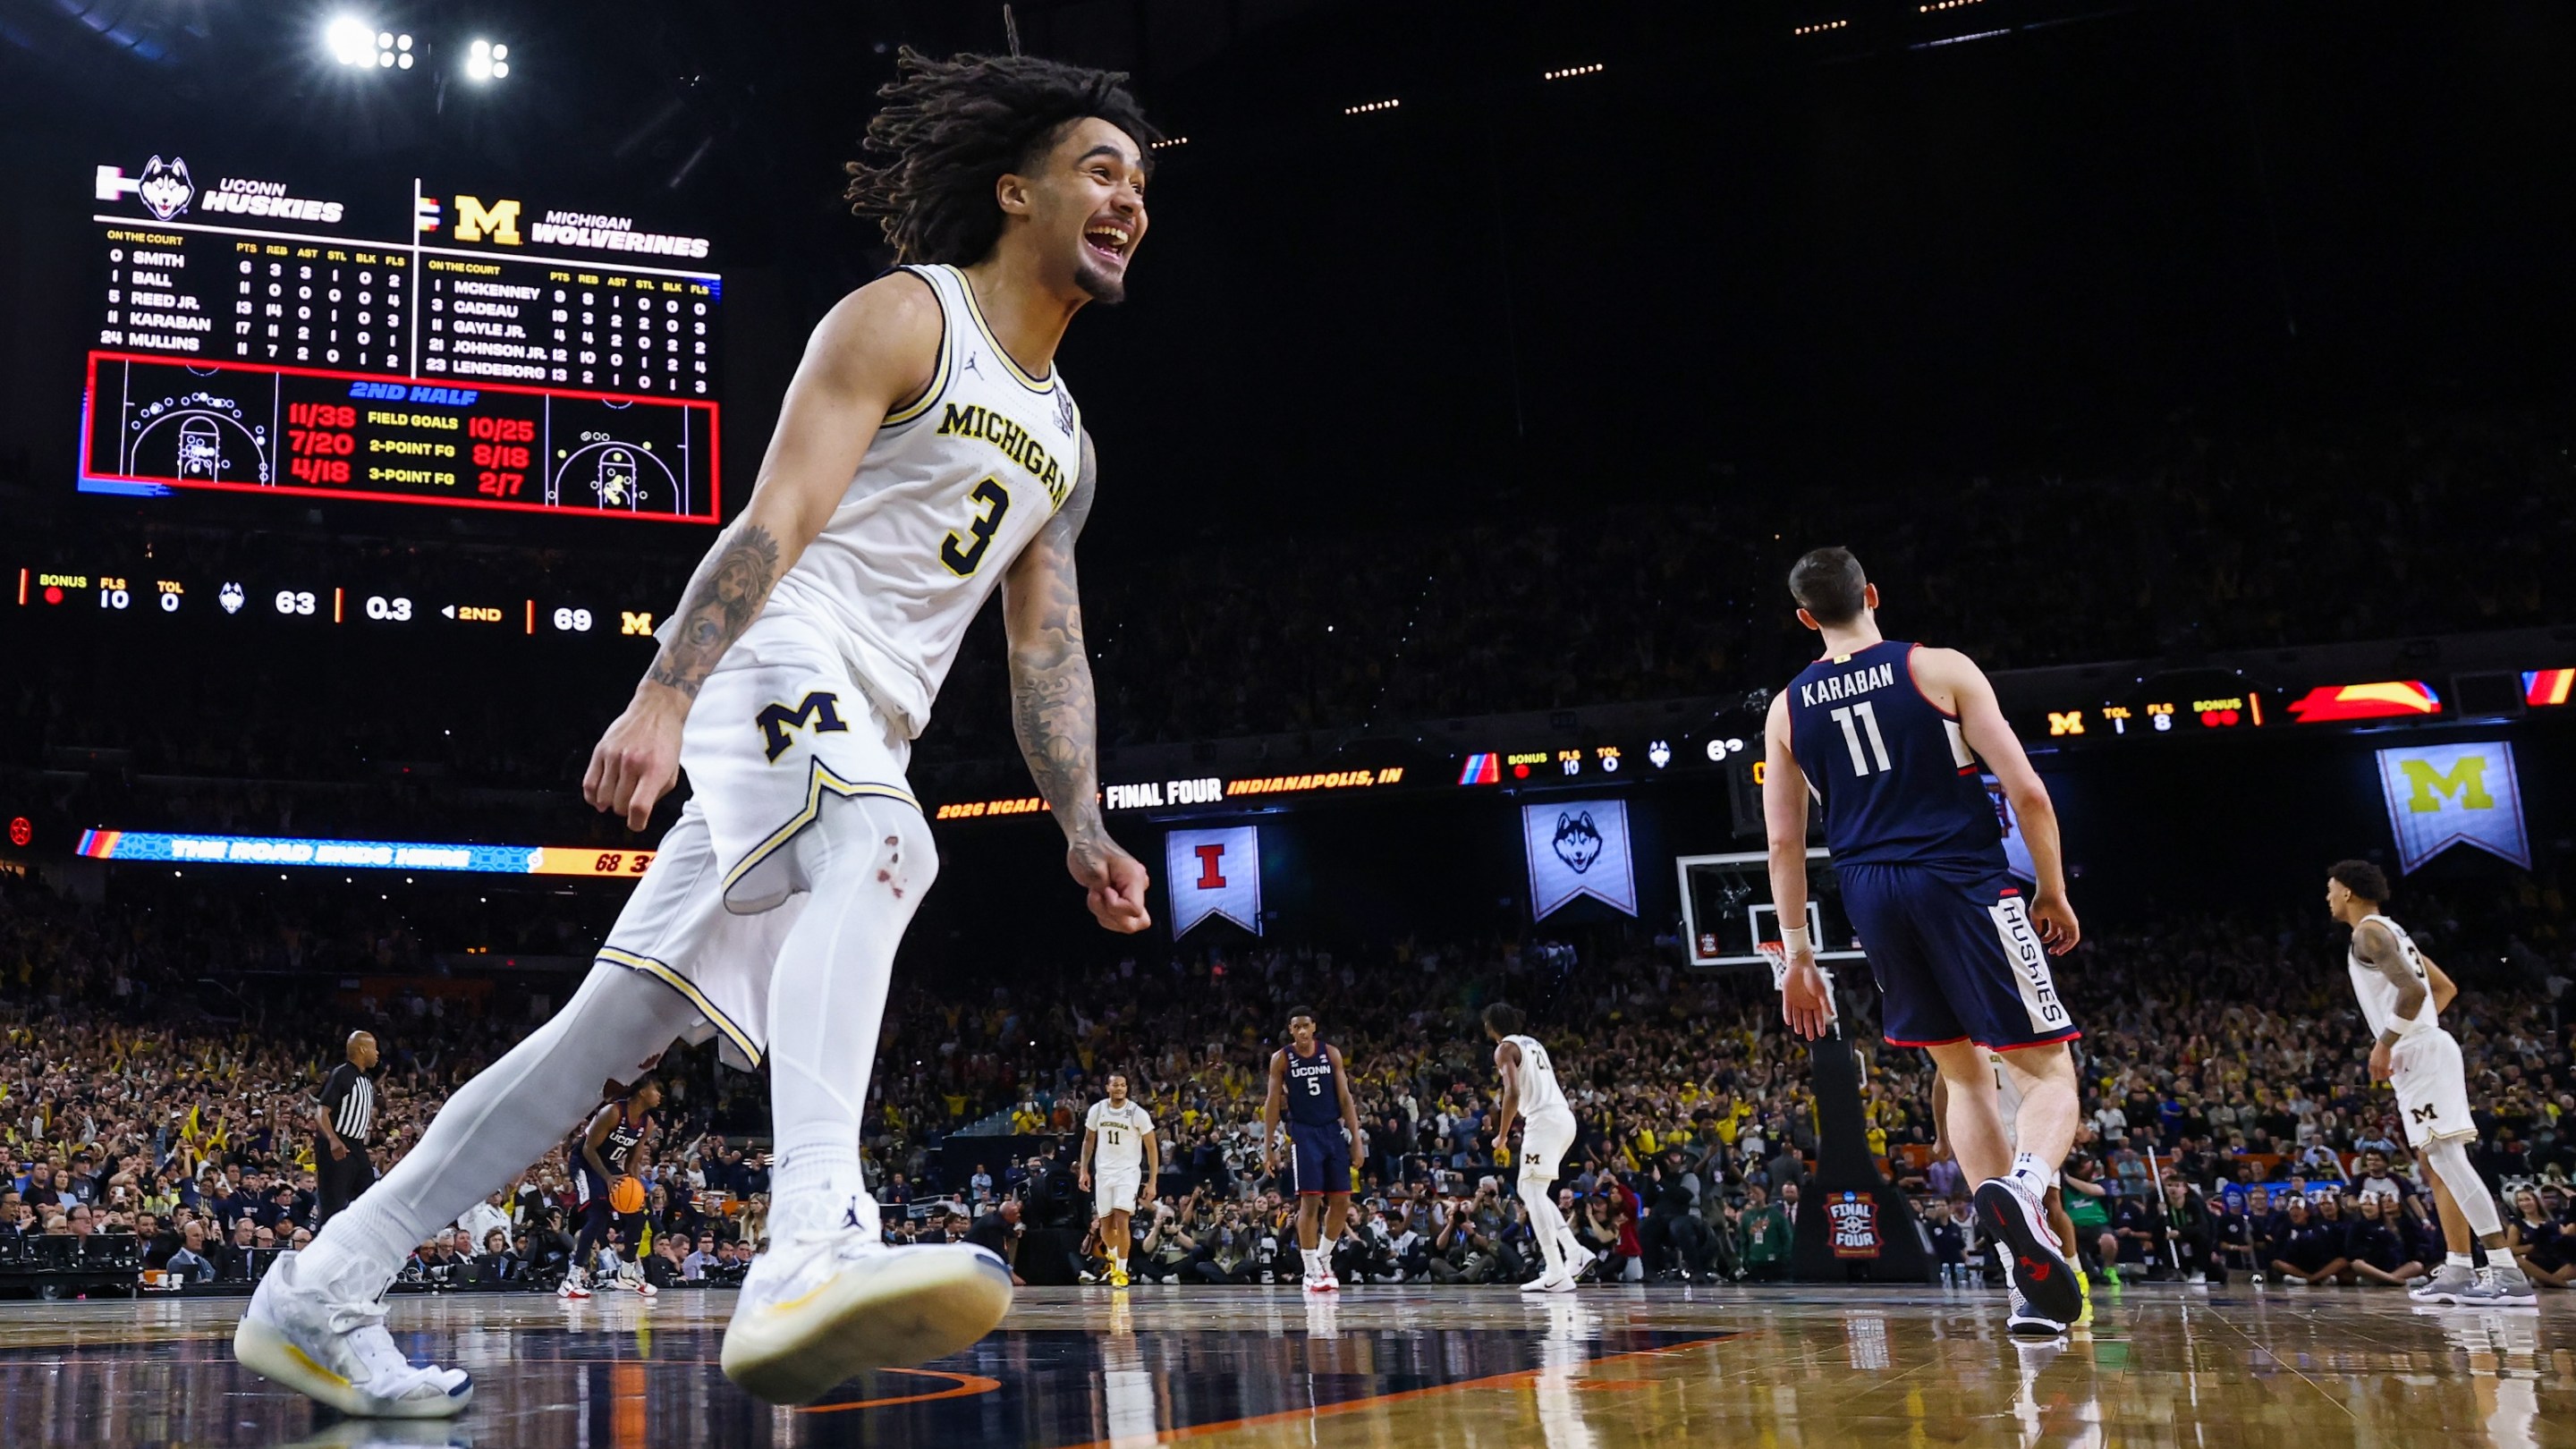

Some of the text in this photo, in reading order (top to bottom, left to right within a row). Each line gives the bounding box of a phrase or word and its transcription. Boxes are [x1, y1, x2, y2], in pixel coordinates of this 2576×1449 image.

[218, 178, 286, 197] UCONN
[202, 191, 344, 223] HUSKIES
[454, 195, 521, 246] M
[546, 210, 631, 231] MICHIGAN
[106, 230, 404, 267] ON THE COURT PTS REB AST STL BLK FLS
[531, 223, 710, 258] WOLVERINES
[110, 249, 400, 287] 0 SMITH 6 3 3 2
[428, 260, 709, 295] ON THE COURT PTS REB AST STL BLK FLS
[113, 269, 400, 307] 1 BALL 11 4
[435, 279, 594, 305] 1 MCKENNEY 9 8
[108, 290, 399, 327] 5 REED JR. 13 14 3
[432, 299, 706, 335] 3 CADEAU 19 3 2 2 3
[107, 310, 309, 340] 11 KARABAN 17 11 2
[432, 318, 706, 354] 11 GAYLE JR. 4 4 2 2 2
[100, 330, 398, 368] 24 MULLINS 11 7 2 0 2
[429, 338, 706, 373] 21 JOHNSON JR. 12 10 0 2 4
[426, 358, 706, 393] 23 LENDEBORG 13 2 0 3
[350, 382, 478, 405] 2ND HALF
[289, 402, 534, 443] 11/38 FIELD GOALS 10/25
[289, 430, 530, 469] 7/20 2-POINT FG 8/18
[292, 458, 523, 497] 4/18 3-POINT FG 2/7
[940, 475, 1010, 577] 3
[40, 574, 87, 589] BONUS
[100, 578, 125, 590] FLS
[157, 580, 183, 594] TOL
[100, 589, 129, 609] 10
[161, 594, 179, 612] 0
[275, 591, 315, 615] 63
[366, 596, 412, 621] 0.3
[459, 606, 502, 622] 2ND
[554, 607, 592, 631] 69
[621, 612, 652, 636] M
[1801, 663, 1894, 708] KARABAN
[2103, 708, 2131, 719] TOL
[2147, 703, 2174, 716] FLS
[2193, 698, 2242, 712] BONUS
[755, 691, 848, 765] M
[2048, 711, 2085, 735] M
[2114, 717, 2124, 734] 1
[2154, 714, 2172, 731] 8
[1830, 700, 1892, 777] 11
[1508, 752, 1547, 765] BONUS
[1558, 750, 1580, 761] FLS
[1597, 747, 1621, 758] TOL
[1603, 757, 1618, 772] 0
[1563, 759, 1580, 775] 10
[1226, 767, 1403, 795] INDIANAPOLIS, IN
[2401, 757, 2493, 813] M
[1106, 778, 1223, 810] FINAL FOUR
[936, 802, 985, 819] 2026
[987, 798, 1040, 816] NCAA
[595, 853, 656, 873] 68 3
[1194, 843, 1226, 890] I
[2004, 905, 2063, 1022] HUSKIES
[1292, 1065, 1331, 1079] UCONN
[1308, 1077, 1322, 1097] 5
[2411, 1103, 2438, 1124] M
[1107, 1130, 1120, 1145] 11
[1525, 1154, 1540, 1165] M
[1830, 1203, 1871, 1219] FINAL
[1835, 1232, 1875, 1247] FOUR
